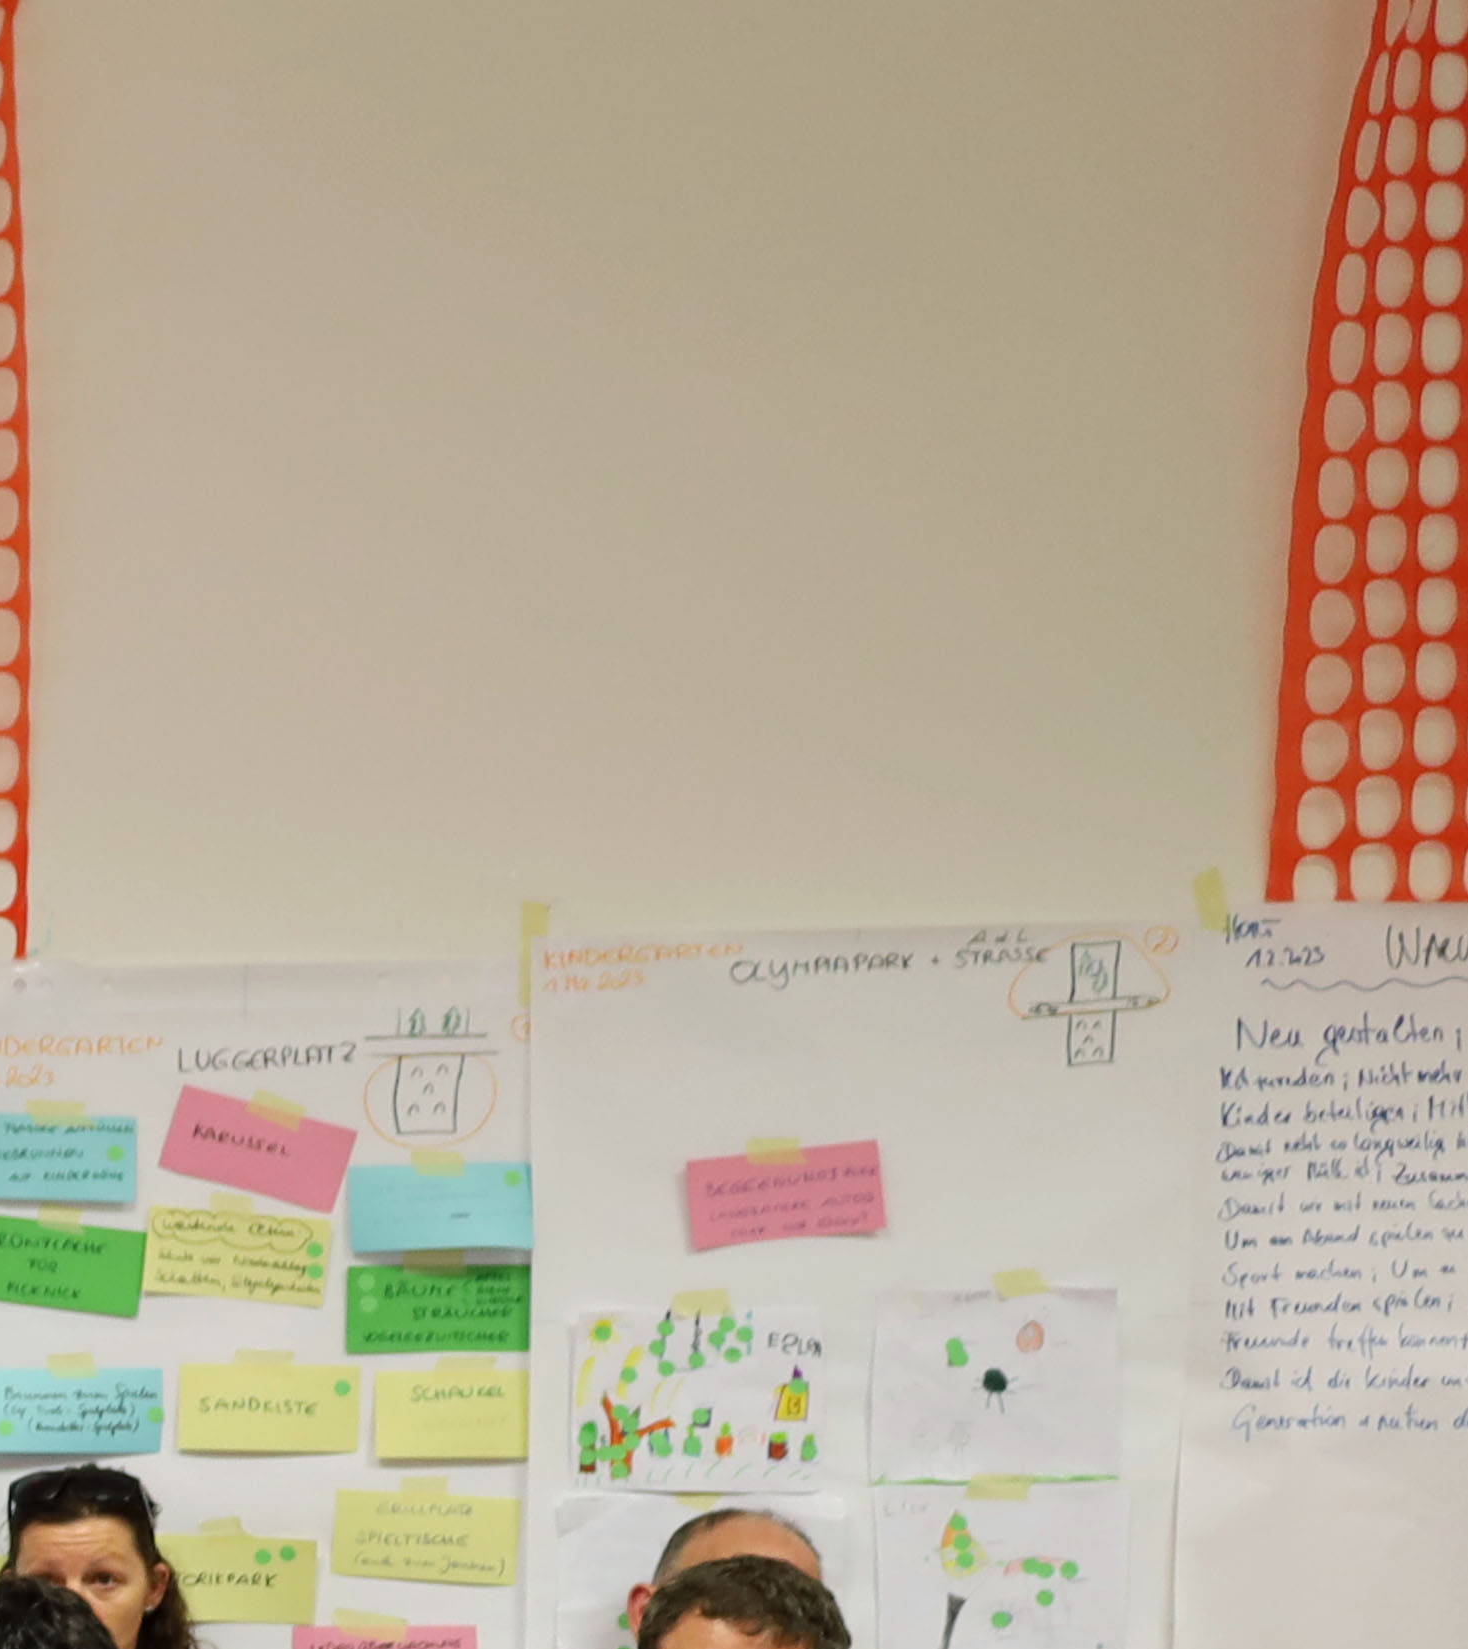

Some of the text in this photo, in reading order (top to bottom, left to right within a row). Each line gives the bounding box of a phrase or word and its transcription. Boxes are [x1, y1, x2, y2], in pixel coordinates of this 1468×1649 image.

[1234, 1015, 1305, 1053] Neu
[176, 1040, 358, 1075] LUGGERPLATZ
[1219, 1100, 1293, 1128] Kinder
[1221, 1260, 1284, 1291] Sport
[198, 1395, 319, 1417] SANDKISTE
